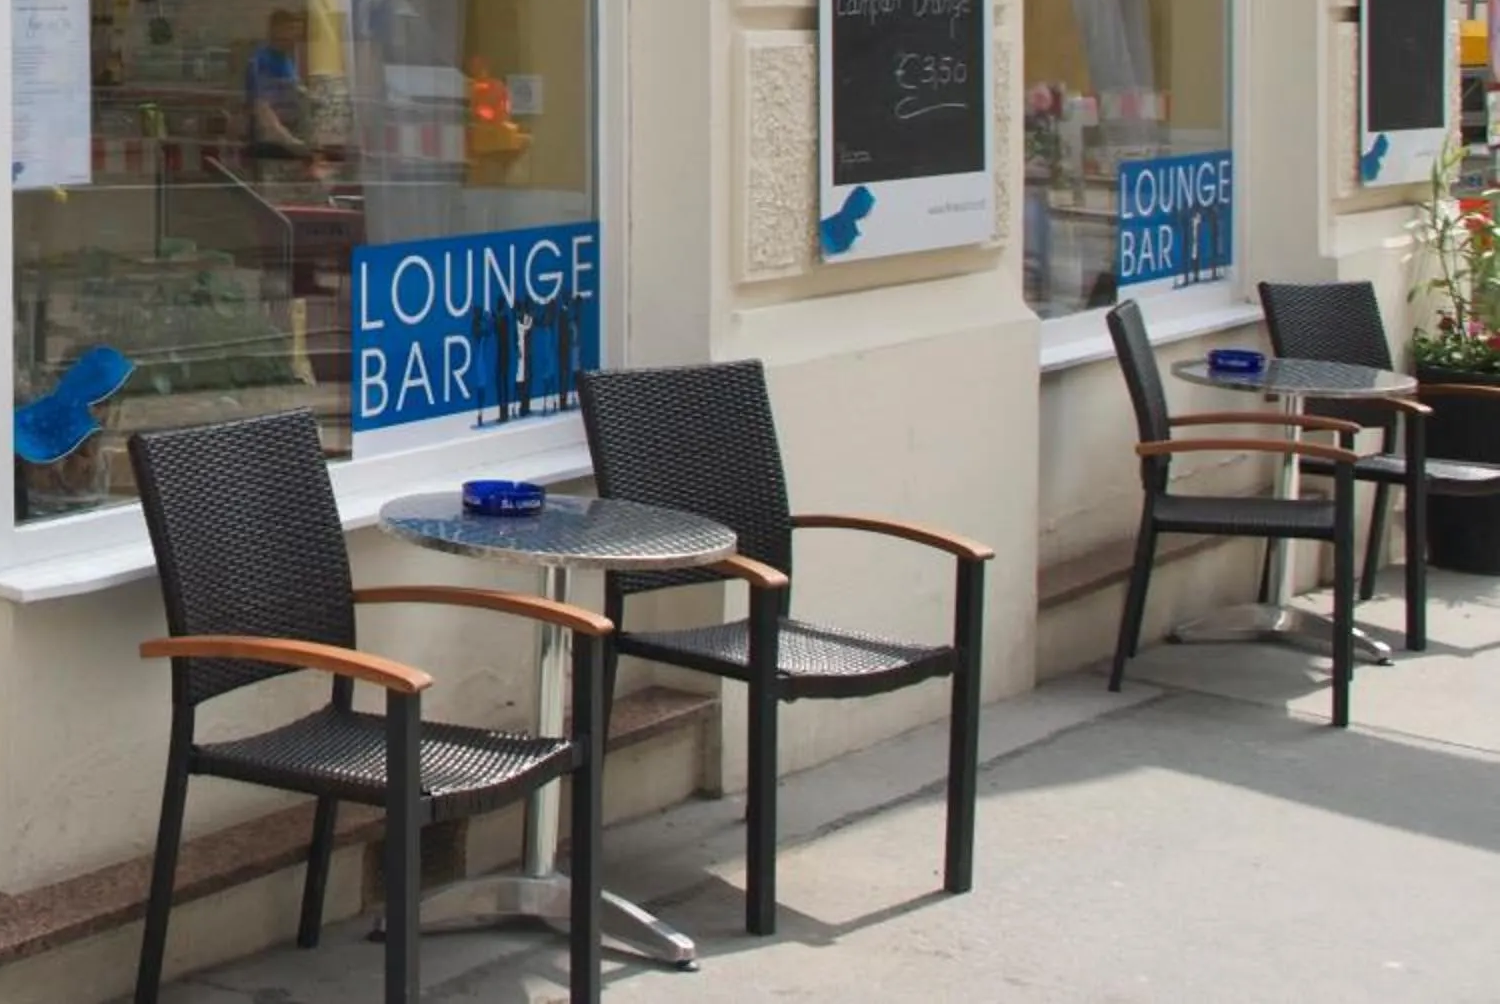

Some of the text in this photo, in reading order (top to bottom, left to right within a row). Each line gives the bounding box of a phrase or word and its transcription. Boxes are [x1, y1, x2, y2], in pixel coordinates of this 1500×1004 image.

[1121, 159, 1231, 219] LOUNGE
[361, 235, 593, 332] LOUNGE
[1121, 224, 1173, 277] BAR
[361, 335, 472, 418] BAR
